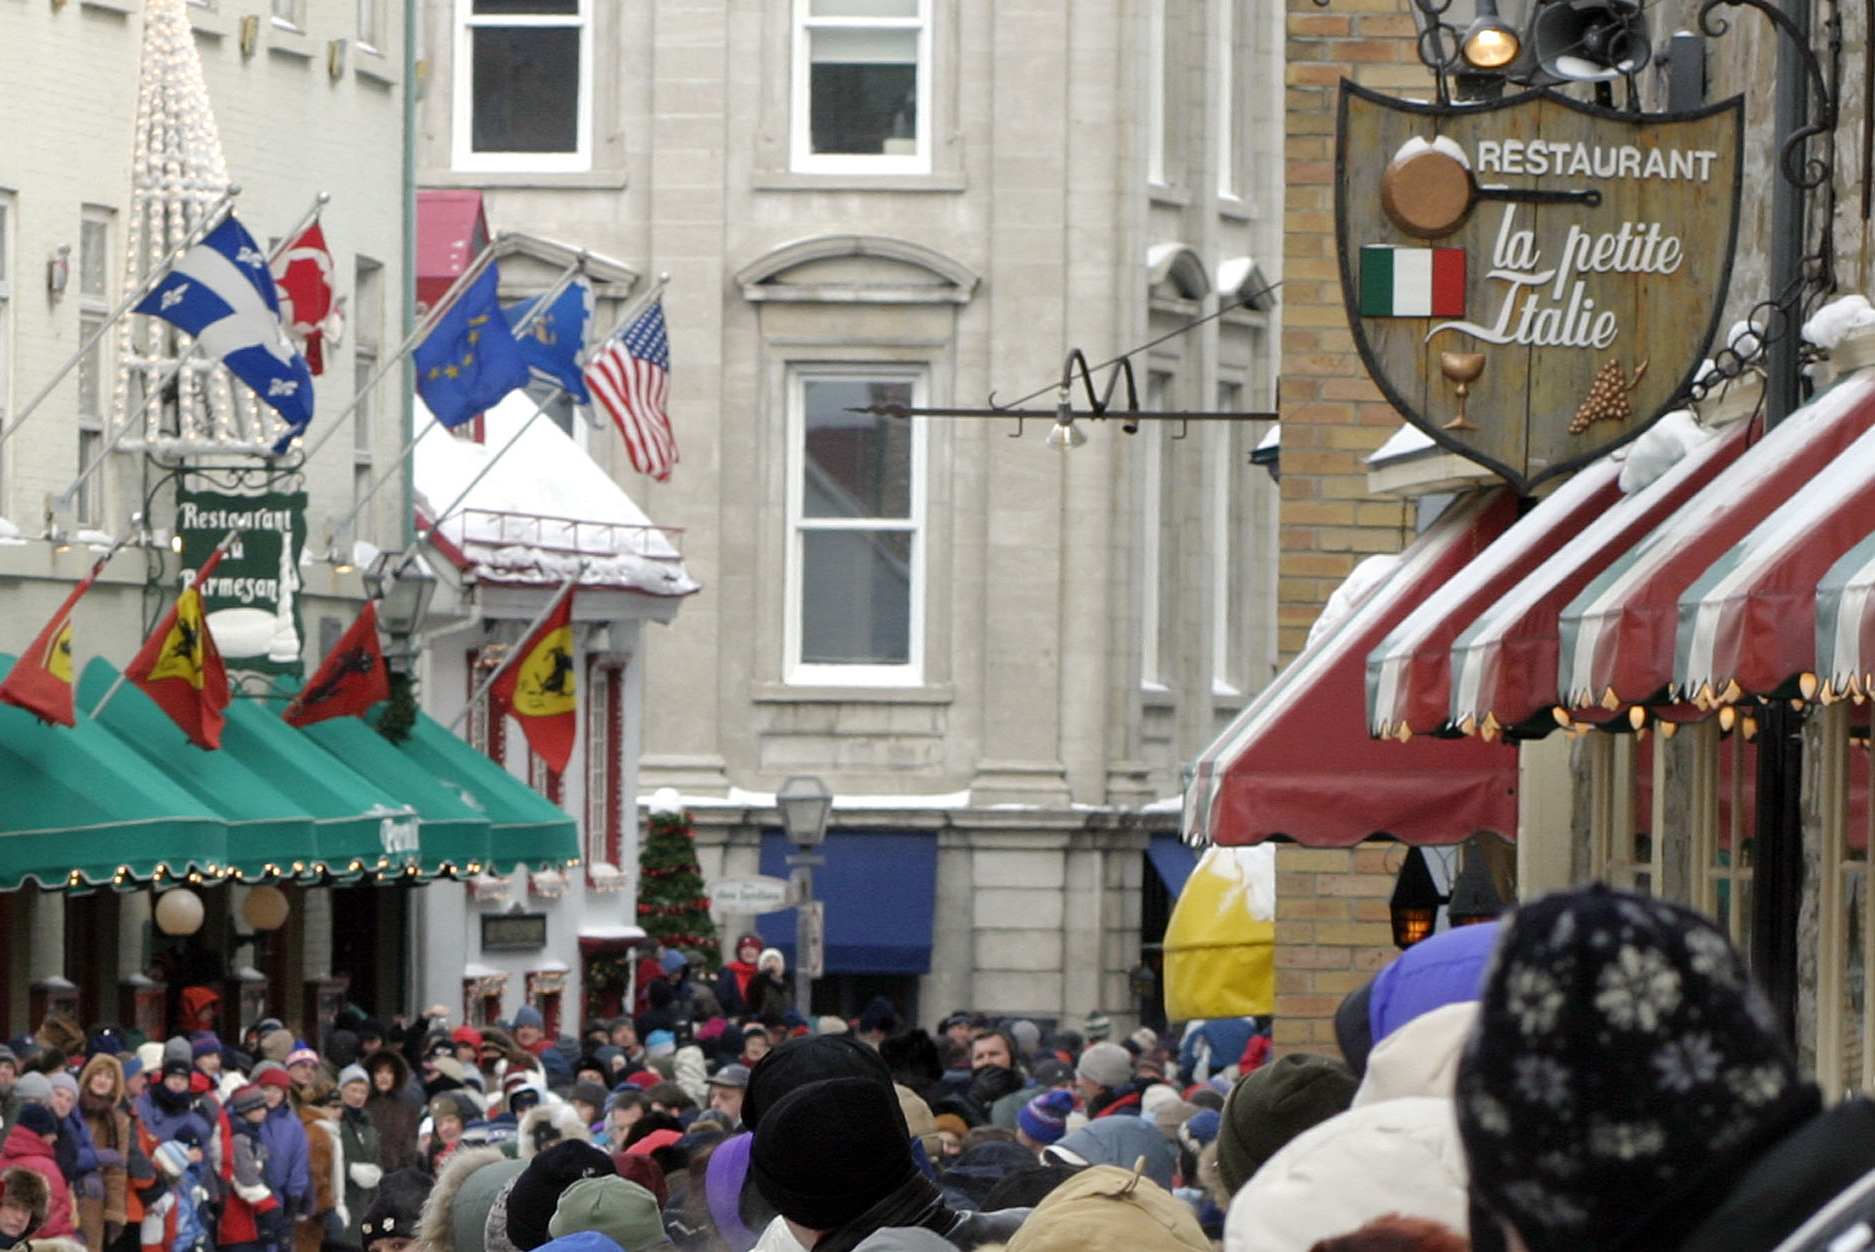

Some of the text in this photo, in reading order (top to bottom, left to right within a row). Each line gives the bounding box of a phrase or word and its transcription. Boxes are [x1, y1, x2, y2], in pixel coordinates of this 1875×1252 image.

[1477, 139, 1718, 183] RESTAURANT
[1492, 203, 1685, 301] la petite
[1425, 269, 1619, 349] Italie
[180, 502, 293, 534] Restaurant
